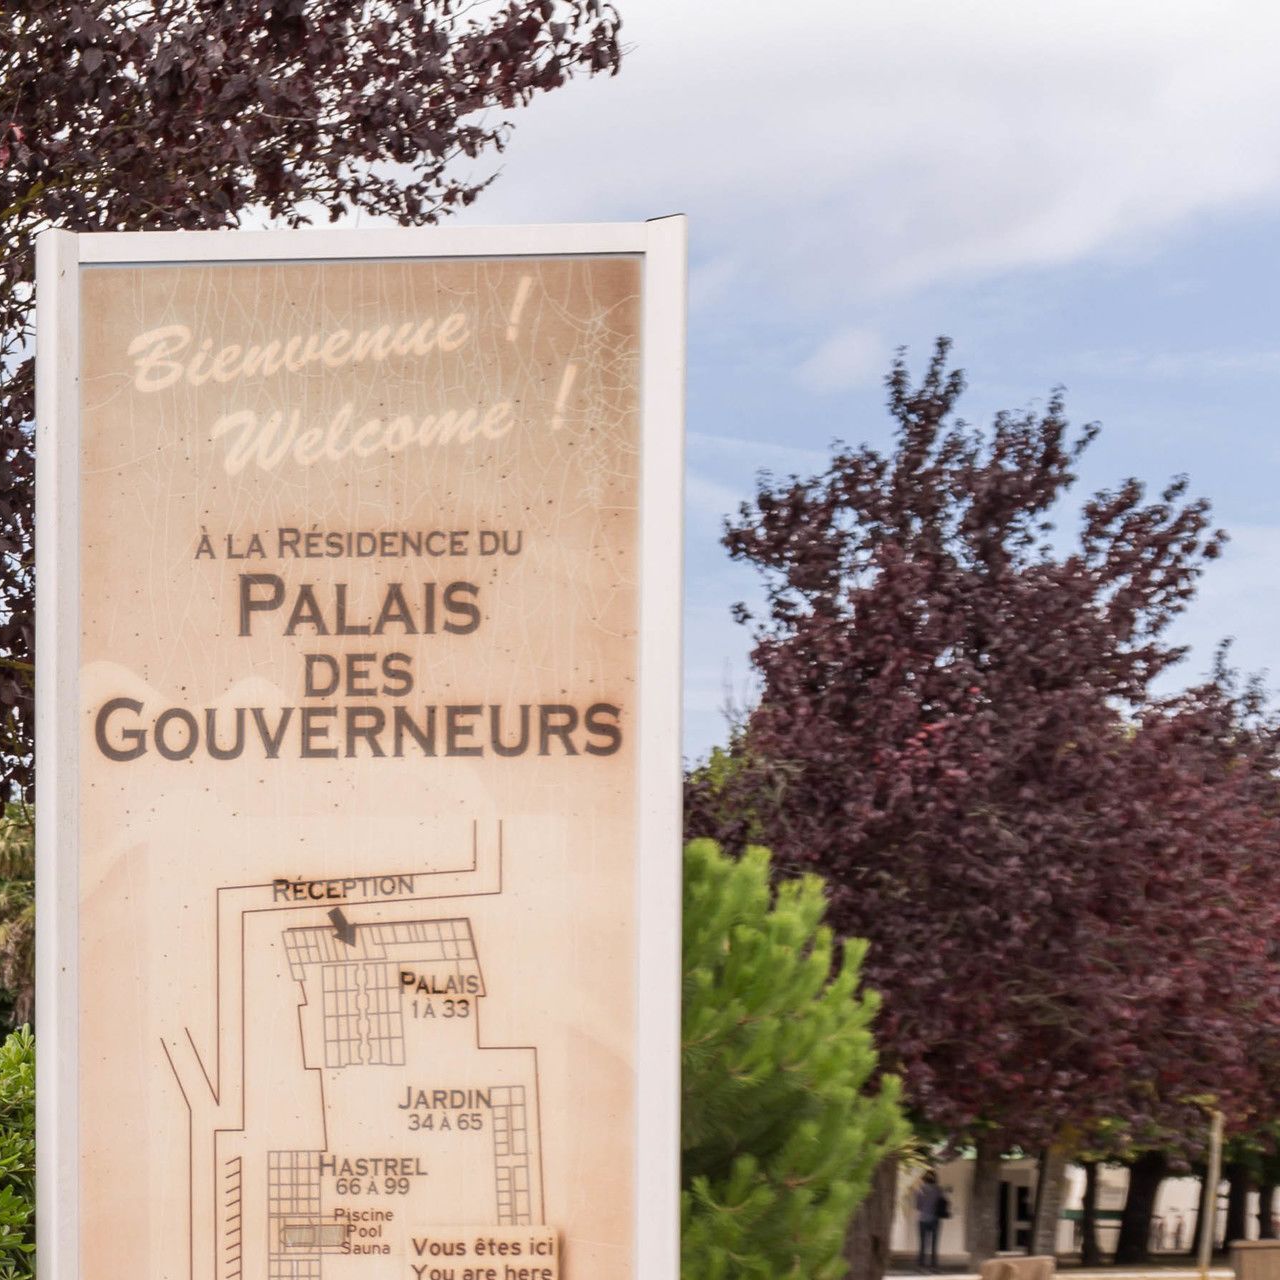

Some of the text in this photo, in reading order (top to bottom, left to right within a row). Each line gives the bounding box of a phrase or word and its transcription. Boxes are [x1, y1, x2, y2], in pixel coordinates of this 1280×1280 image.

[128, 311, 471, 393] Bienvenue
[213, 399, 515, 476] Welcome
[194, 526, 523, 560] À LA RÉSIDENCE DU
[238, 573, 481, 638] PALAIS
[304, 652, 414, 698] DES
[94, 697, 623, 763] GOUVERNEURS
[273, 874, 415, 903] RÉCEPTION
[400, 971, 479, 995] PALAIS
[412, 1000, 419, 1018] 1
[443, 1000, 470, 1019] 33
[398, 1086, 491, 1110] JARDIN
[407, 1112, 434, 1131] 34
[458, 1112, 483, 1131] 65
[319, 1155, 428, 1176] HASTREL
[336, 1177, 362, 1195] 66
[385, 1177, 410, 1195] 99
[333, 1207, 394, 1222] Piscine
[346, 1224, 383, 1239] Pool
[340, 1241, 391, 1255] Sauna
[411, 1236, 554, 1257] Vous êtes ici
